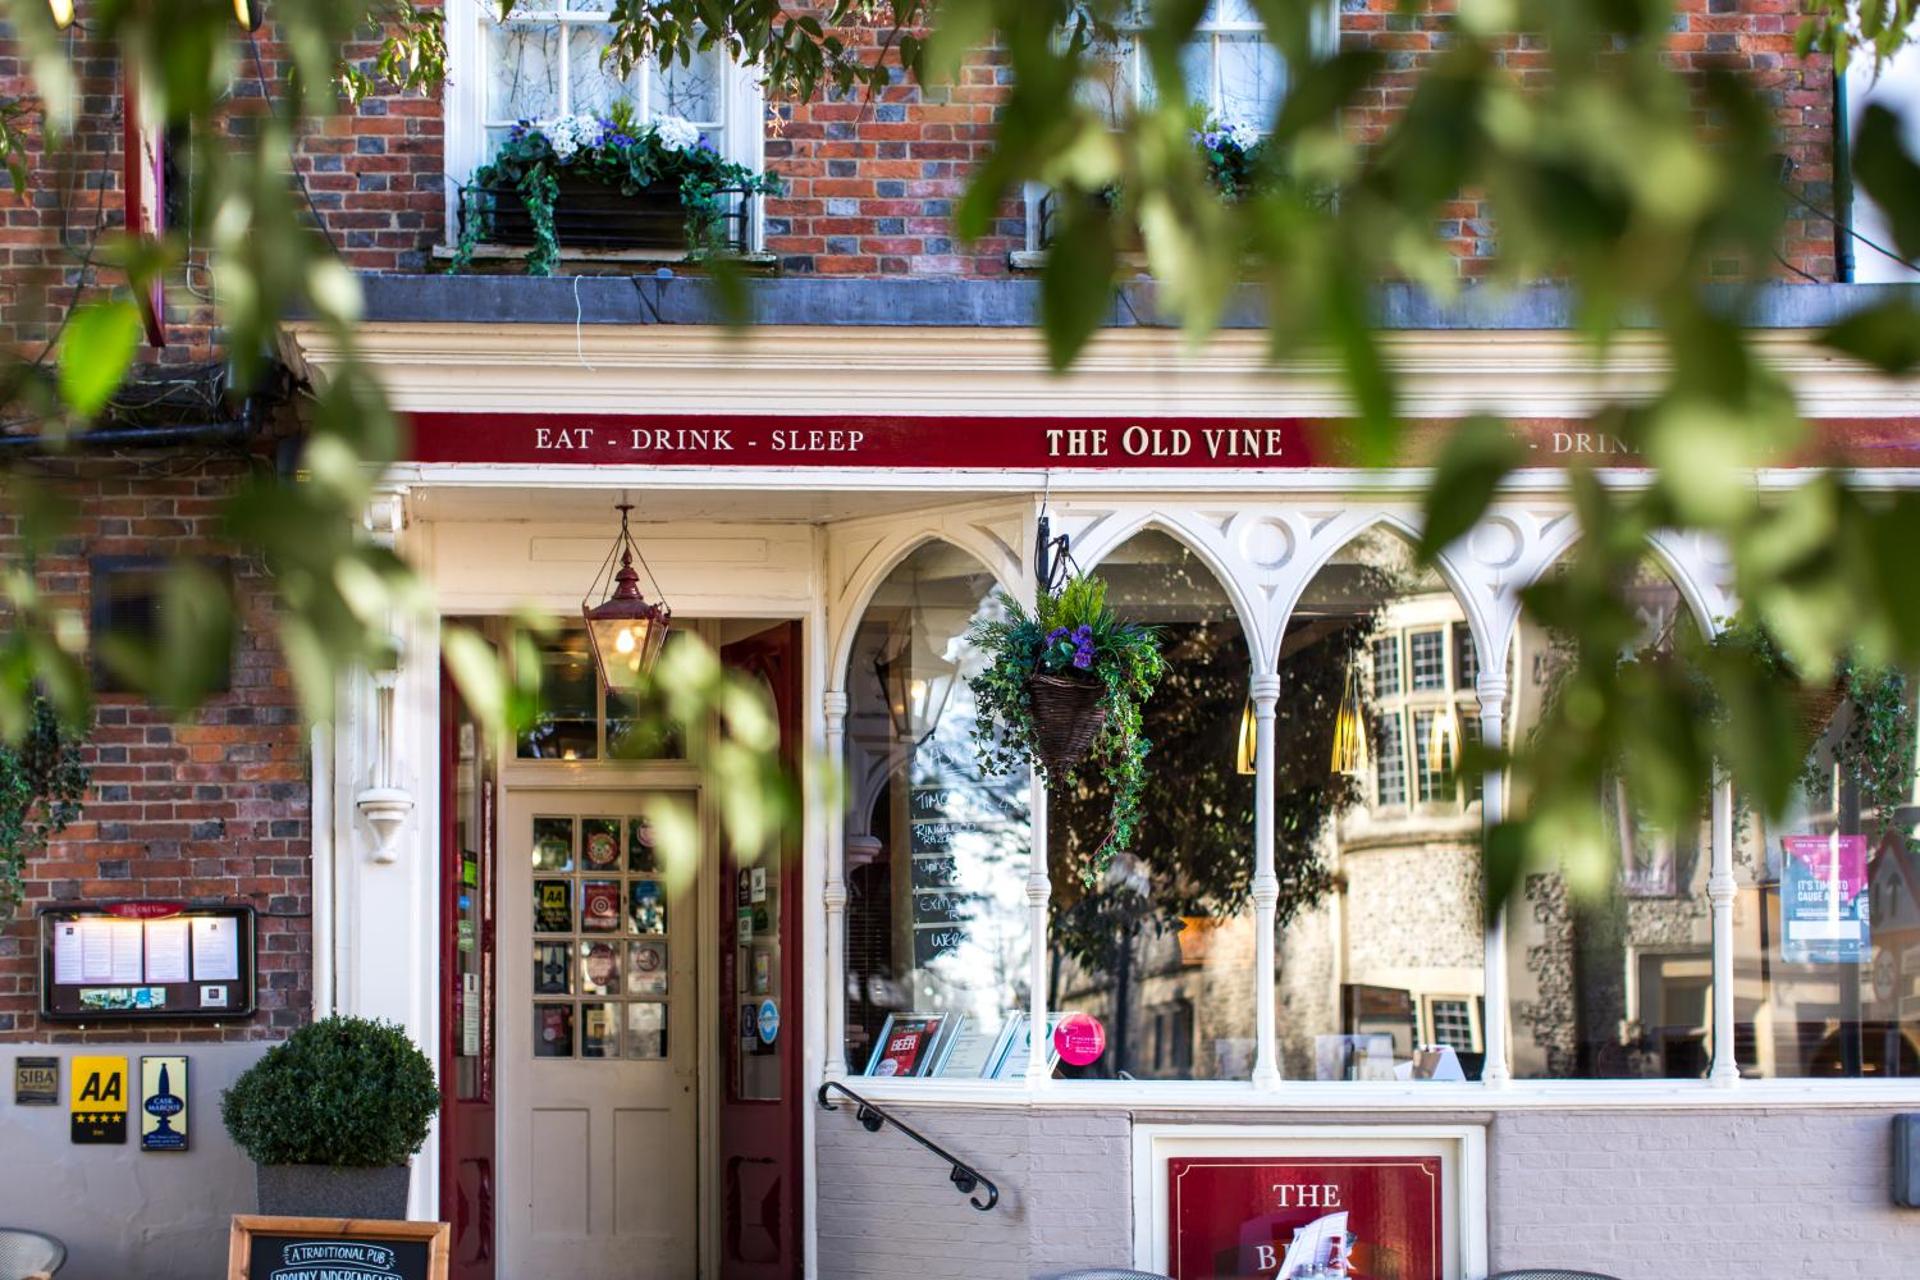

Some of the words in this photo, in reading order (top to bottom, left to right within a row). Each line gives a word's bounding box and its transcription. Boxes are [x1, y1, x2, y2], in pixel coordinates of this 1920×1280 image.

[535, 428, 594, 449] EAT
[631, 429, 734, 450] DRINK
[771, 430, 865, 451] SLEEP
[1046, 429, 1108, 456] THE
[1122, 426, 1192, 456] OLD
[1202, 429, 1283, 459] VINE
[1553, 433, 1640, 454] DRIN
[546, 889, 563, 902] AA
[890, 1035, 917, 1052] BEER
[19, 1069, 54, 1084] SIBA
[79, 1072, 121, 1102] AA
[1272, 1184, 1341, 1207] THE
[291, 1247, 300, 1262] A
[300, 1246, 365, 1260] TRADITIONAL
[366, 1248, 385, 1264] PUB
